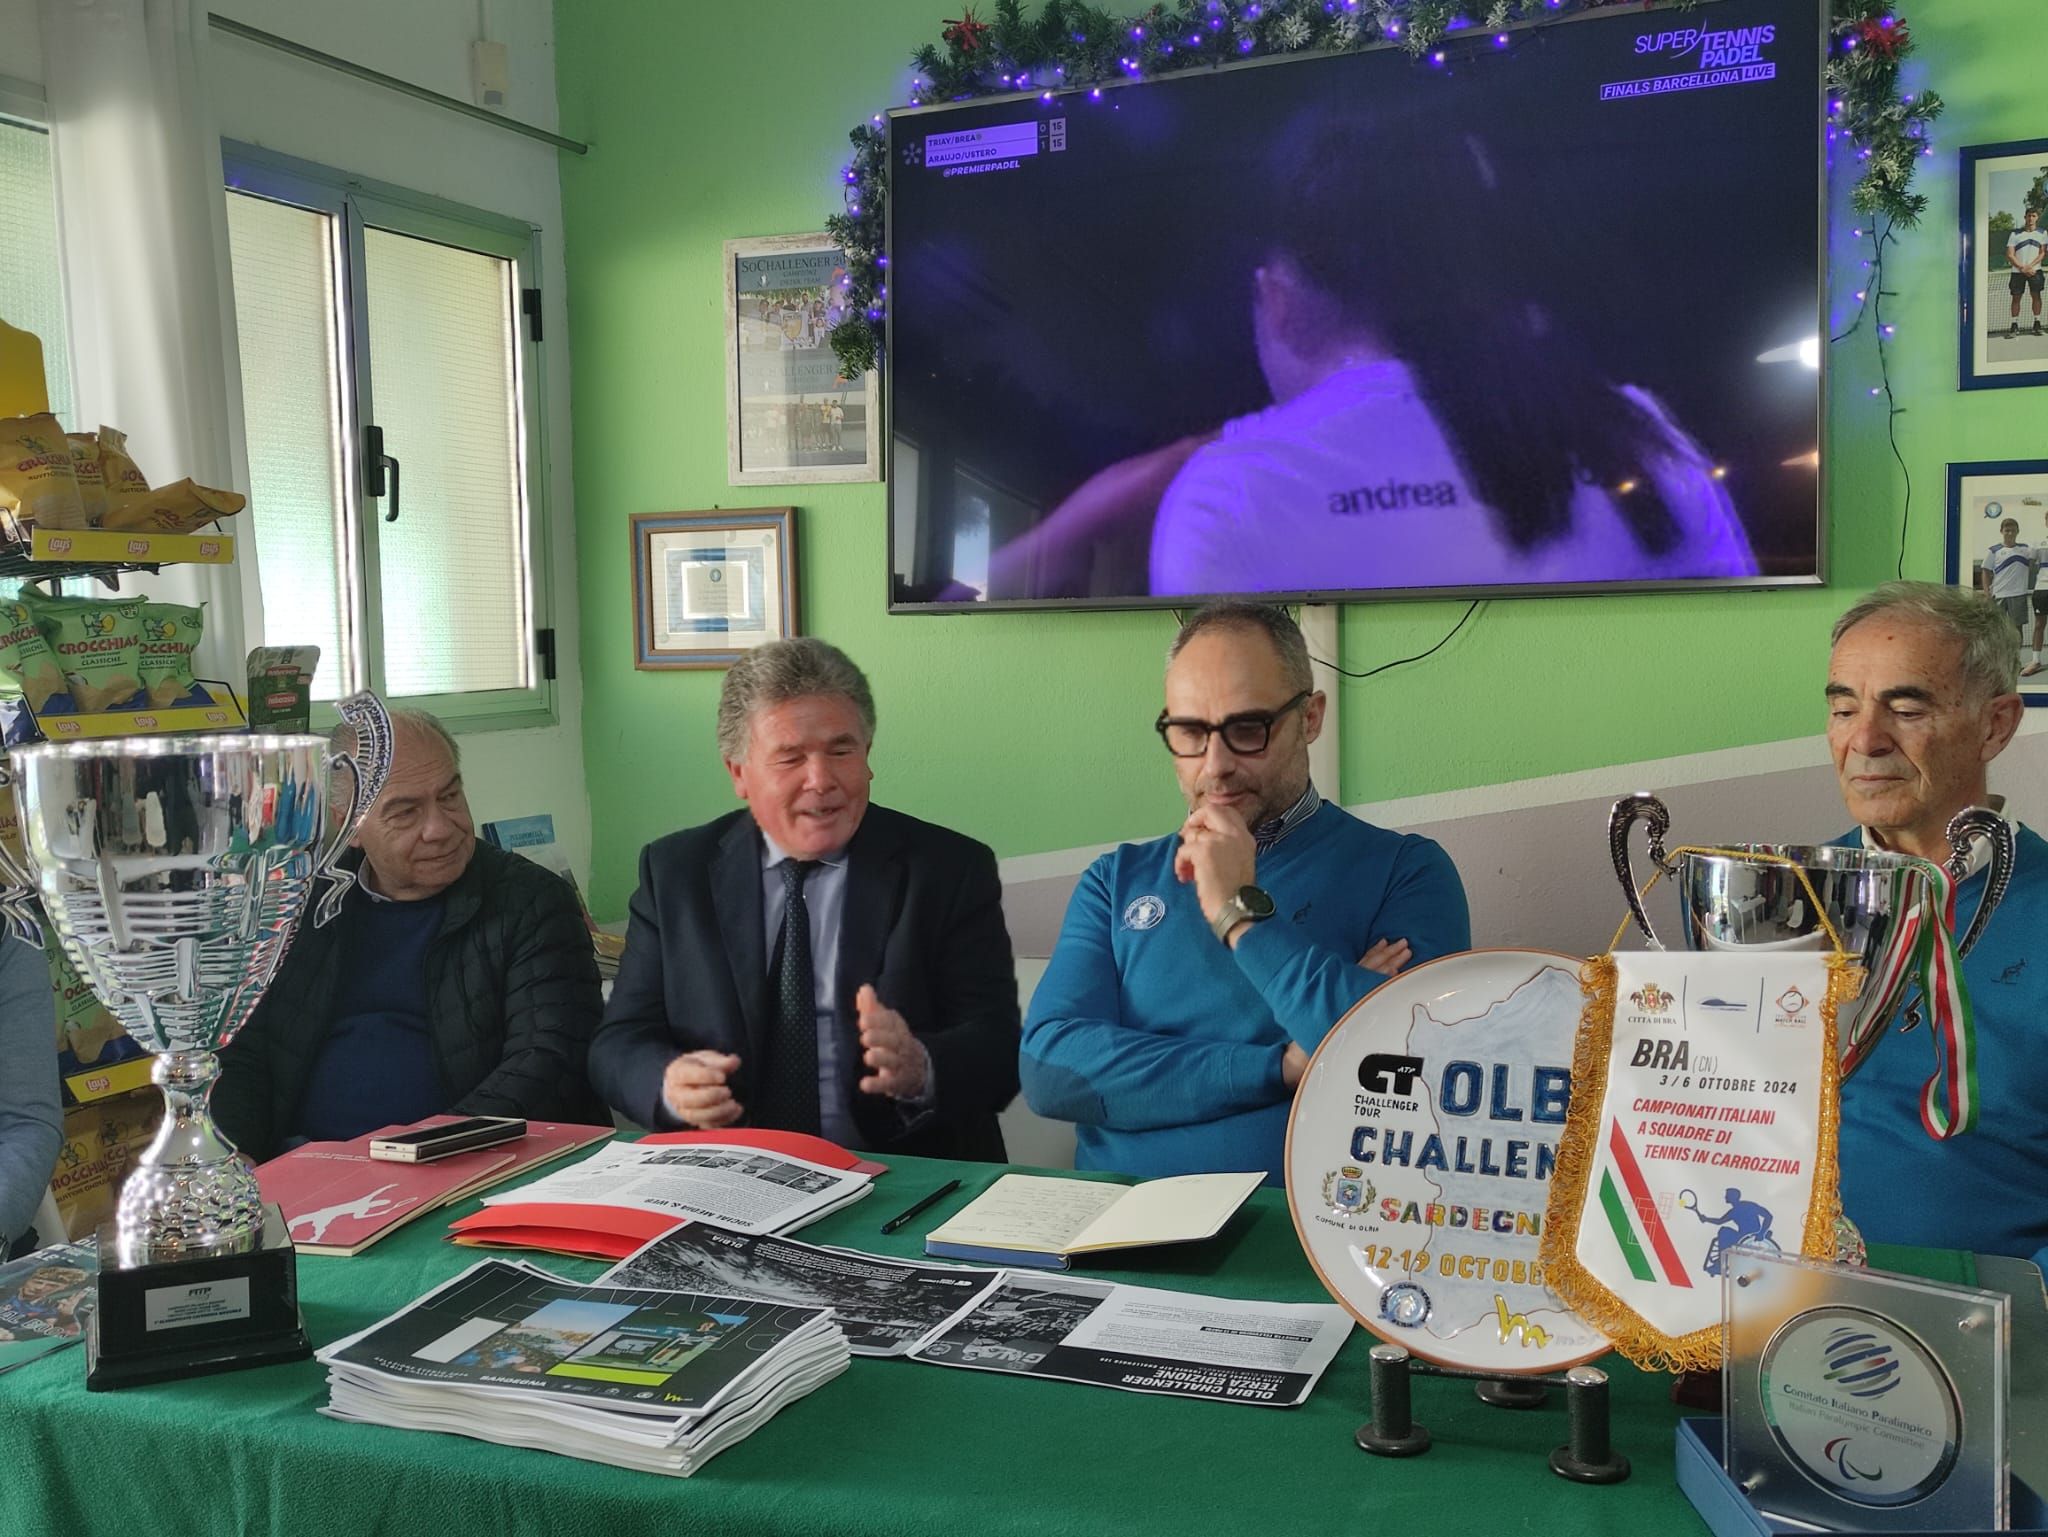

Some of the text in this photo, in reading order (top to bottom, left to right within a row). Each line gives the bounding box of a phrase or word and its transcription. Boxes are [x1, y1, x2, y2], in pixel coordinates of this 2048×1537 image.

[1634, 24, 1776, 54] SUPER TENNIS
[1700, 44, 1763, 69] PADEL
[1603, 65, 1774, 98] FINALS BARCELLONA LIVE
[928, 133, 976, 147] TRIAY/BREA
[1052, 122, 1062, 131] 15
[928, 148, 998, 164] ARAUJO/USTERO
[1052, 138, 1062, 148] 15
[943, 160, 1021, 178] @PREMIERPADEL
[1328, 477, 1457, 514] andrea
[57, 634, 139, 655] CROCCHIAS
[1653, 1017, 1661, 1025] DI
[1661, 1017, 1677, 1025] BRA
[1630, 1038, 1719, 1075] BRA (CN)
[1439, 1059, 1572, 1125] OLB
[1699, 1077, 1756, 1093] OTTOBRE
[1763, 1080, 1798, 1095] 2024
[1353, 1105, 1381, 1118] TOUR
[1354, 1094, 1419, 1112] CHALLENGER
[1632, 1098, 1776, 1125] CAMPIONATI ITALIANI
[1637, 1121, 1733, 1144] A SQUADRE DI
[1350, 1126, 1559, 1180] CHALLEN
[1644, 1144, 1801, 1175] TENNIS IN CARROZZINA
[1379, 1198, 1541, 1236] SARDEGN
[711, 1234, 744, 1249] OLBIA
[1364, 1243, 1544, 1285] 12-19 OCTOBE
[1121, 1374, 1275, 1400] OLBIA CHALLENGER
[1153, 1369, 1279, 1392] TERZA EDIZIONE
[1783, 1383, 1933, 1437] Comitato Italiano Paralimpico
[1788, 1401, 1925, 1449] Italian Paralympic Committee
